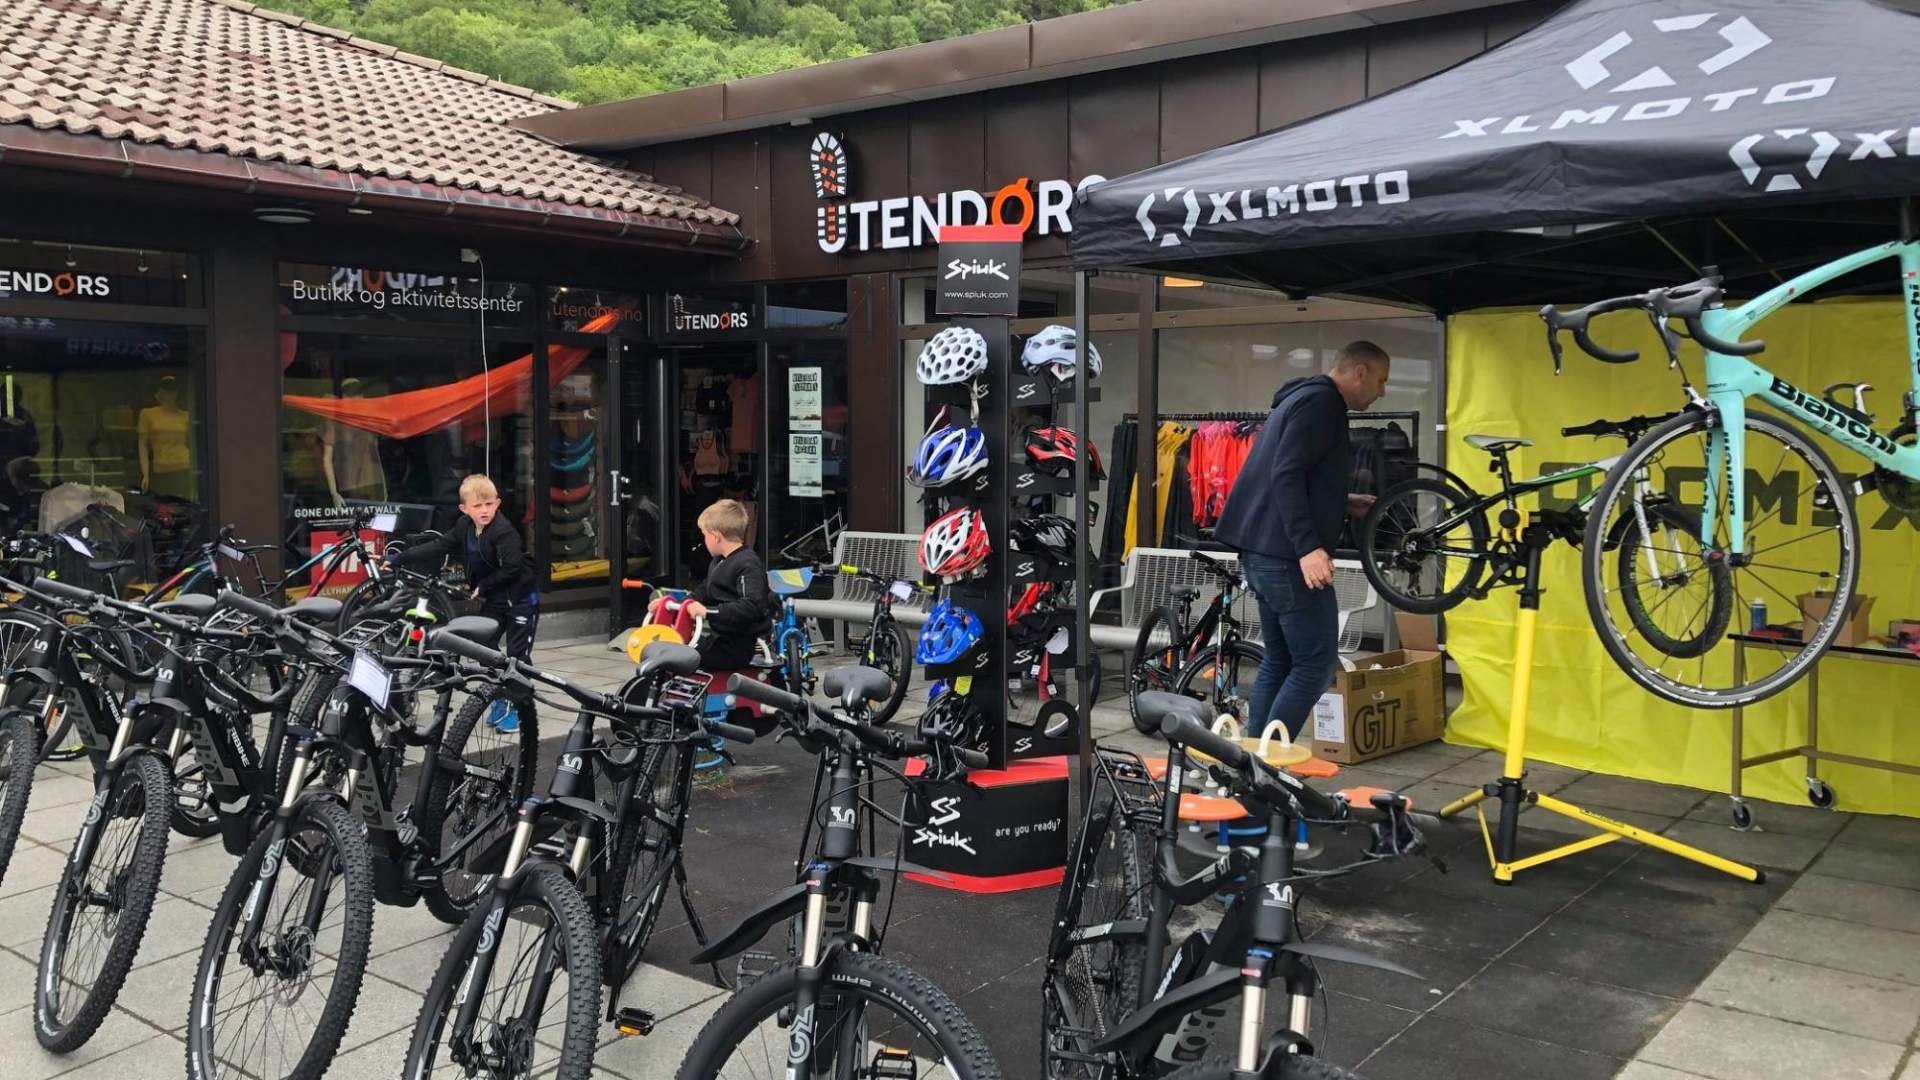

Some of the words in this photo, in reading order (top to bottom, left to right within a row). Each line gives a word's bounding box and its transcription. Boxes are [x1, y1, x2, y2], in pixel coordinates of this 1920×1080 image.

[1437, 76, 1837, 139] XLMOTO
[817, 174, 1107, 254] UTENDØR
[1208, 169, 1410, 225] XLMOTO
[944, 257, 1010, 281] Spiuk
[293, 279, 353, 303] Butikk
[360, 289, 385, 310] og
[392, 289, 524, 313] aktivitetssenter
[944, 289, 1009, 300] www.spiuk.com
[1769, 375, 1897, 456] Bianchi
[294, 508, 322, 518] GONE
[324, 507, 339, 516] ON
[340, 506, 355, 516] MY
[358, 504, 402, 515] ATWALK
[1352, 697, 1401, 755] GT
[912, 826, 977, 855] Spiuk
[995, 827, 1011, 837] are
[1014, 825, 1030, 838] you
[1033, 818, 1061, 833] ready?
